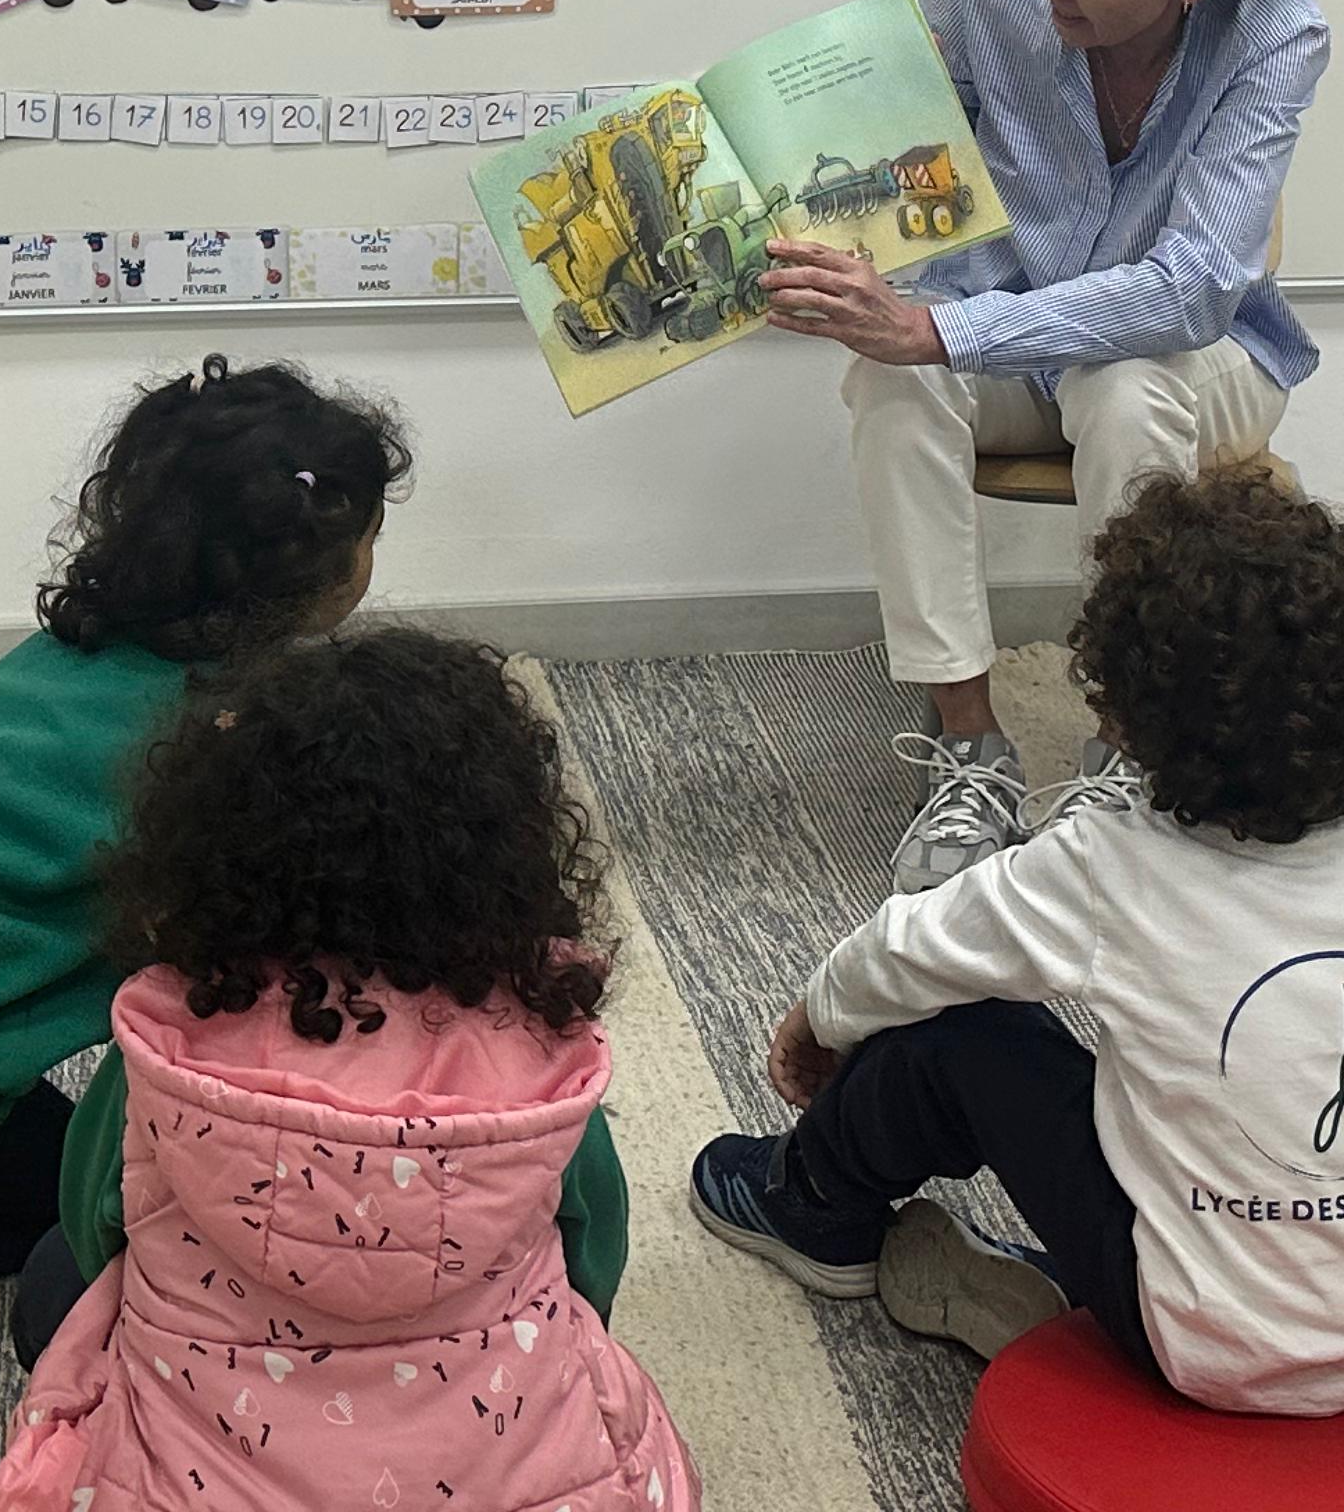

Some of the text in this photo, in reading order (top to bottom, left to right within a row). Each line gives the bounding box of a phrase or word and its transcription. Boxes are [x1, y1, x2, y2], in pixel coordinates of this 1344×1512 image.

[18, 100, 47, 122] 15
[73, 104, 102, 126] 16
[126, 104, 157, 128] 17
[185, 105, 213, 129] 18
[239, 105, 267, 129] 19
[339, 102, 369, 127] 21
[395, 108, 426, 132] 22
[440, 102, 472, 129] 23
[486, 101, 518, 125] 24
[534, 104, 566, 128] 25
[182, 283, 228, 296] FEVRIER
[358, 281, 391, 292] MARS
[8, 288, 56, 301] JANVIER
[1192, 1187, 1281, 1222] LYCÉE
